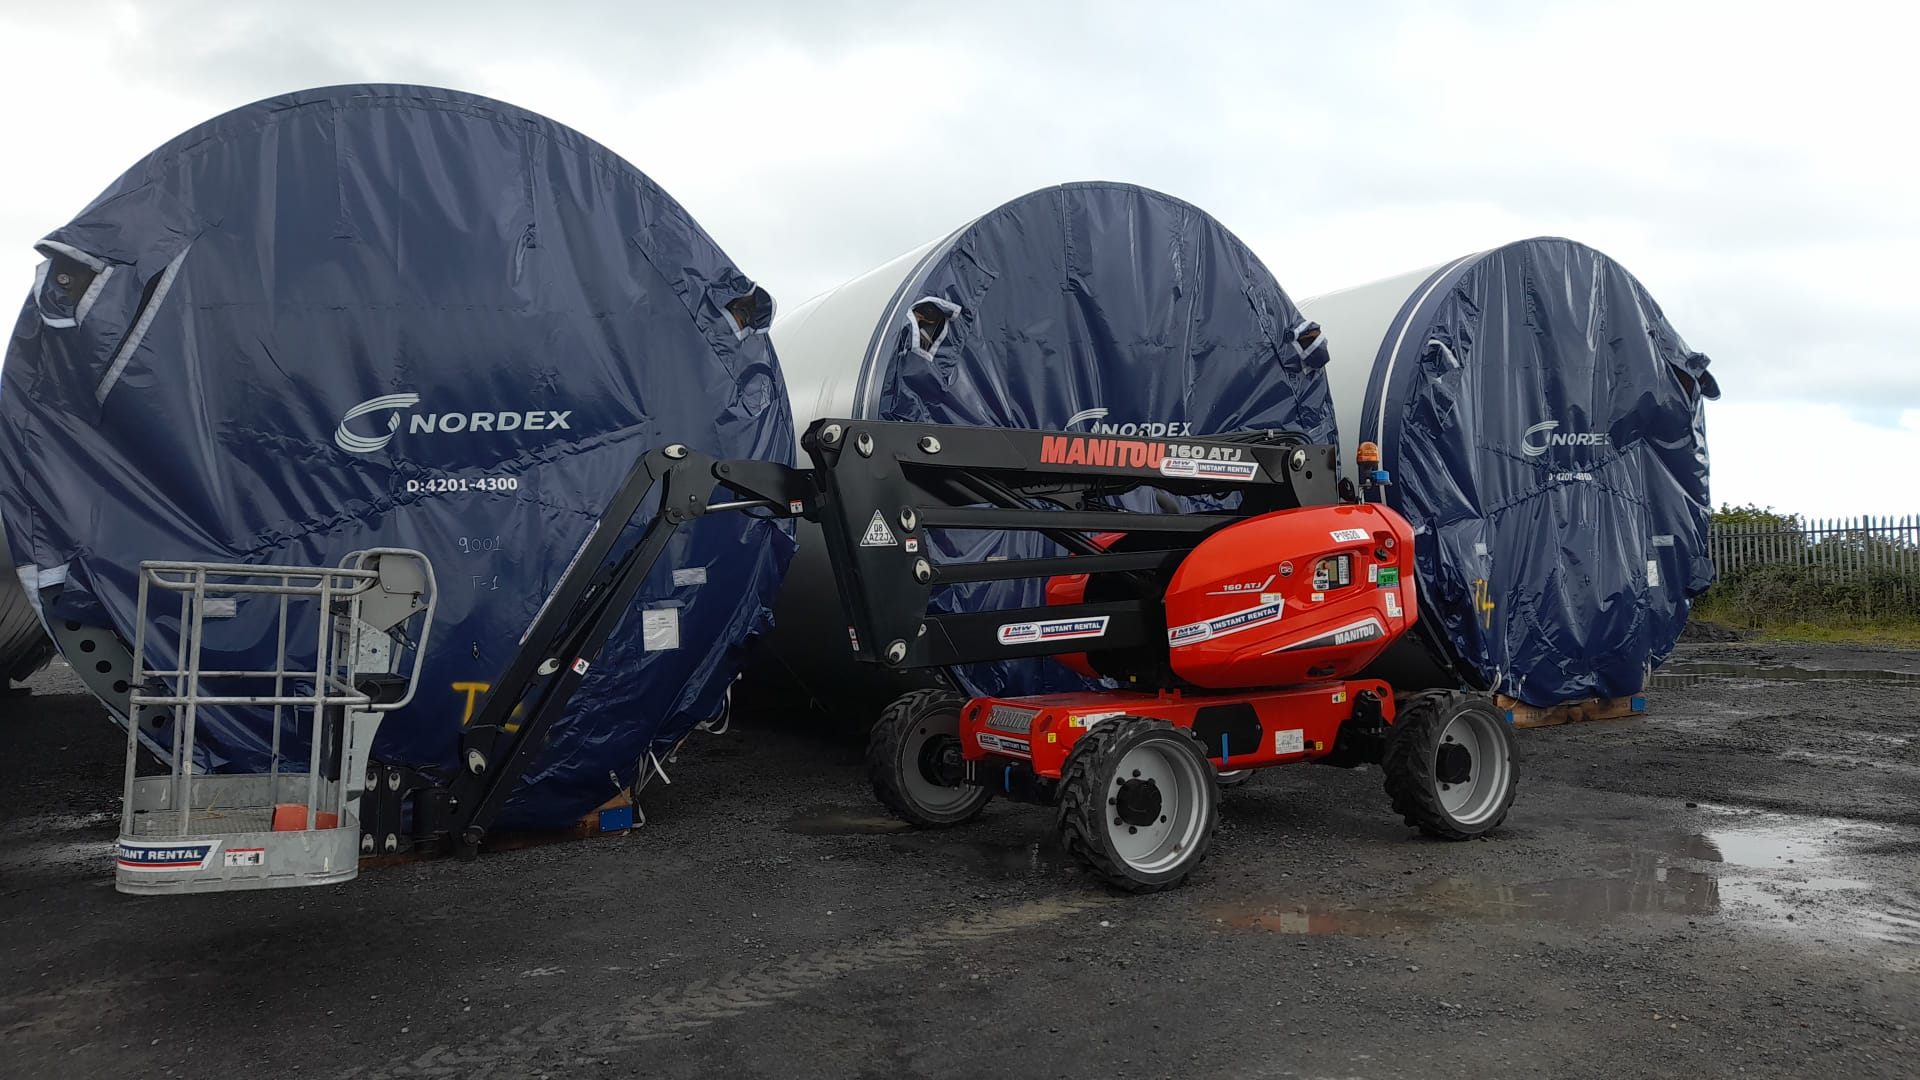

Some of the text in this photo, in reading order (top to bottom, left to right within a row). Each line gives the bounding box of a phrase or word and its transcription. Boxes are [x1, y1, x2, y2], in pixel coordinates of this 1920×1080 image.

[409, 410, 572, 434] NORDEX
[1040, 435, 1167, 469] MANITOU
[1168, 444, 1242, 462] 160 ATJ
[1199, 464, 1226, 472] INSTANT
[406, 477, 518, 493] D:4201-4300
[1243, 582, 1261, 590] ATJ
[1213, 607, 1277, 629] INSTANT RENTAL
[1042, 624, 1073, 633] INSTANT
[1074, 622, 1101, 631] RENTAL
[1334, 624, 1375, 645] MANITOU
[148, 849, 203, 861] RENTAL
